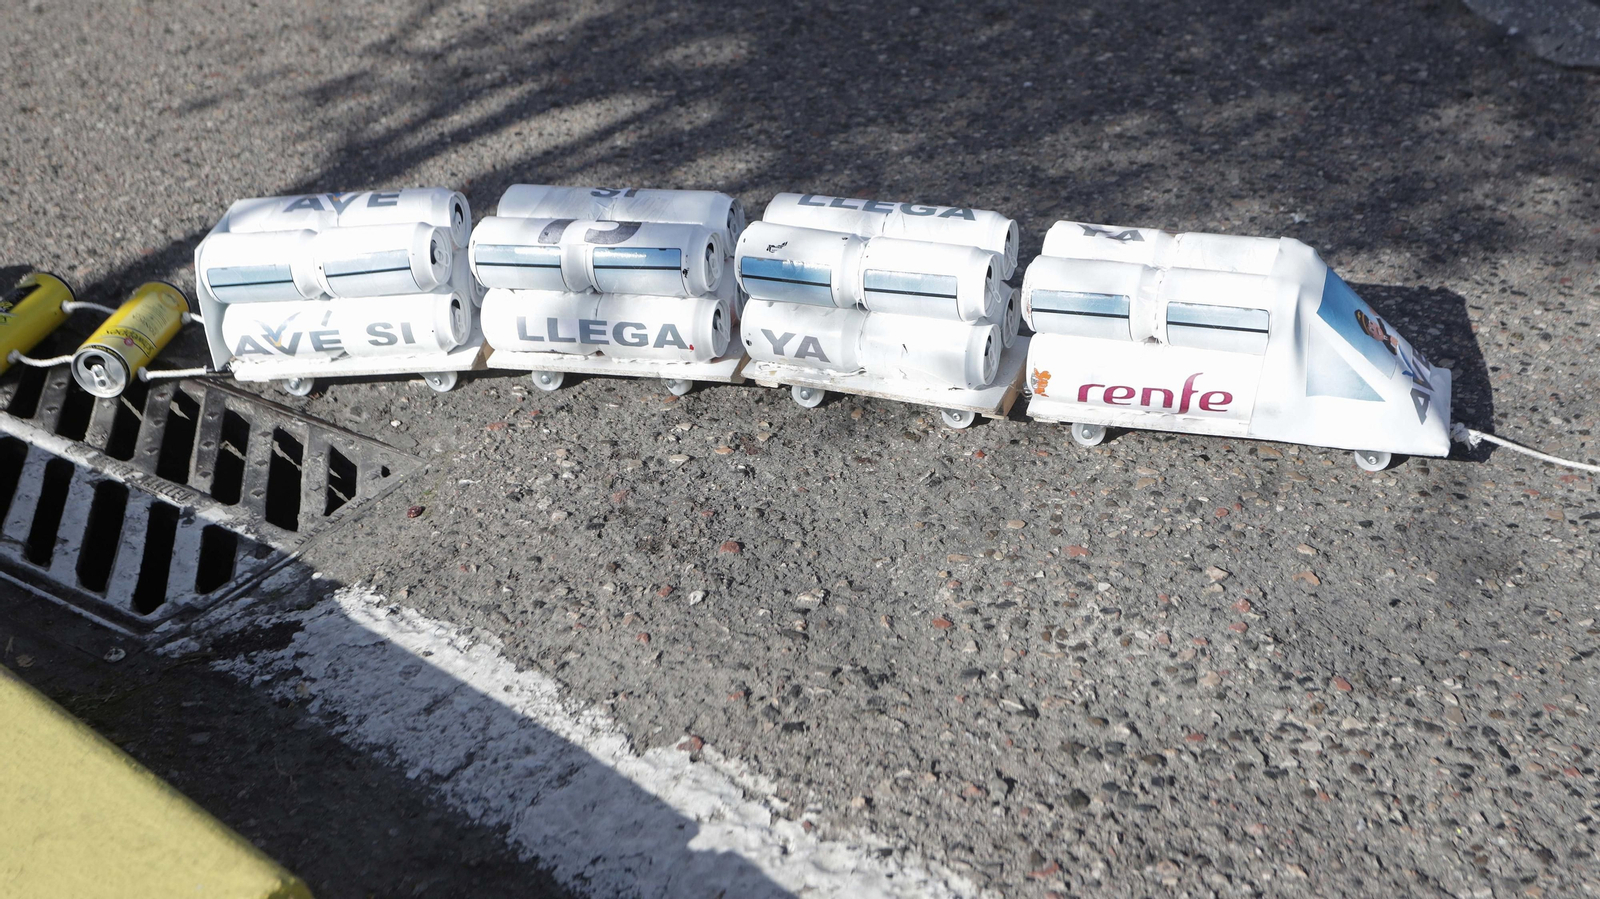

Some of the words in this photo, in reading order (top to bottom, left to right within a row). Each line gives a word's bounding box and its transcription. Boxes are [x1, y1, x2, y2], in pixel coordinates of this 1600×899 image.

[282, 192, 401, 215] AVE
[797, 194, 976, 221] LLEGA
[1077, 224, 1145, 244] YA
[366, 322, 416, 347] SI
[516, 316, 690, 350] LLEGA
[760, 328, 831, 364] YA
[1077, 372, 1234, 415] renfe
